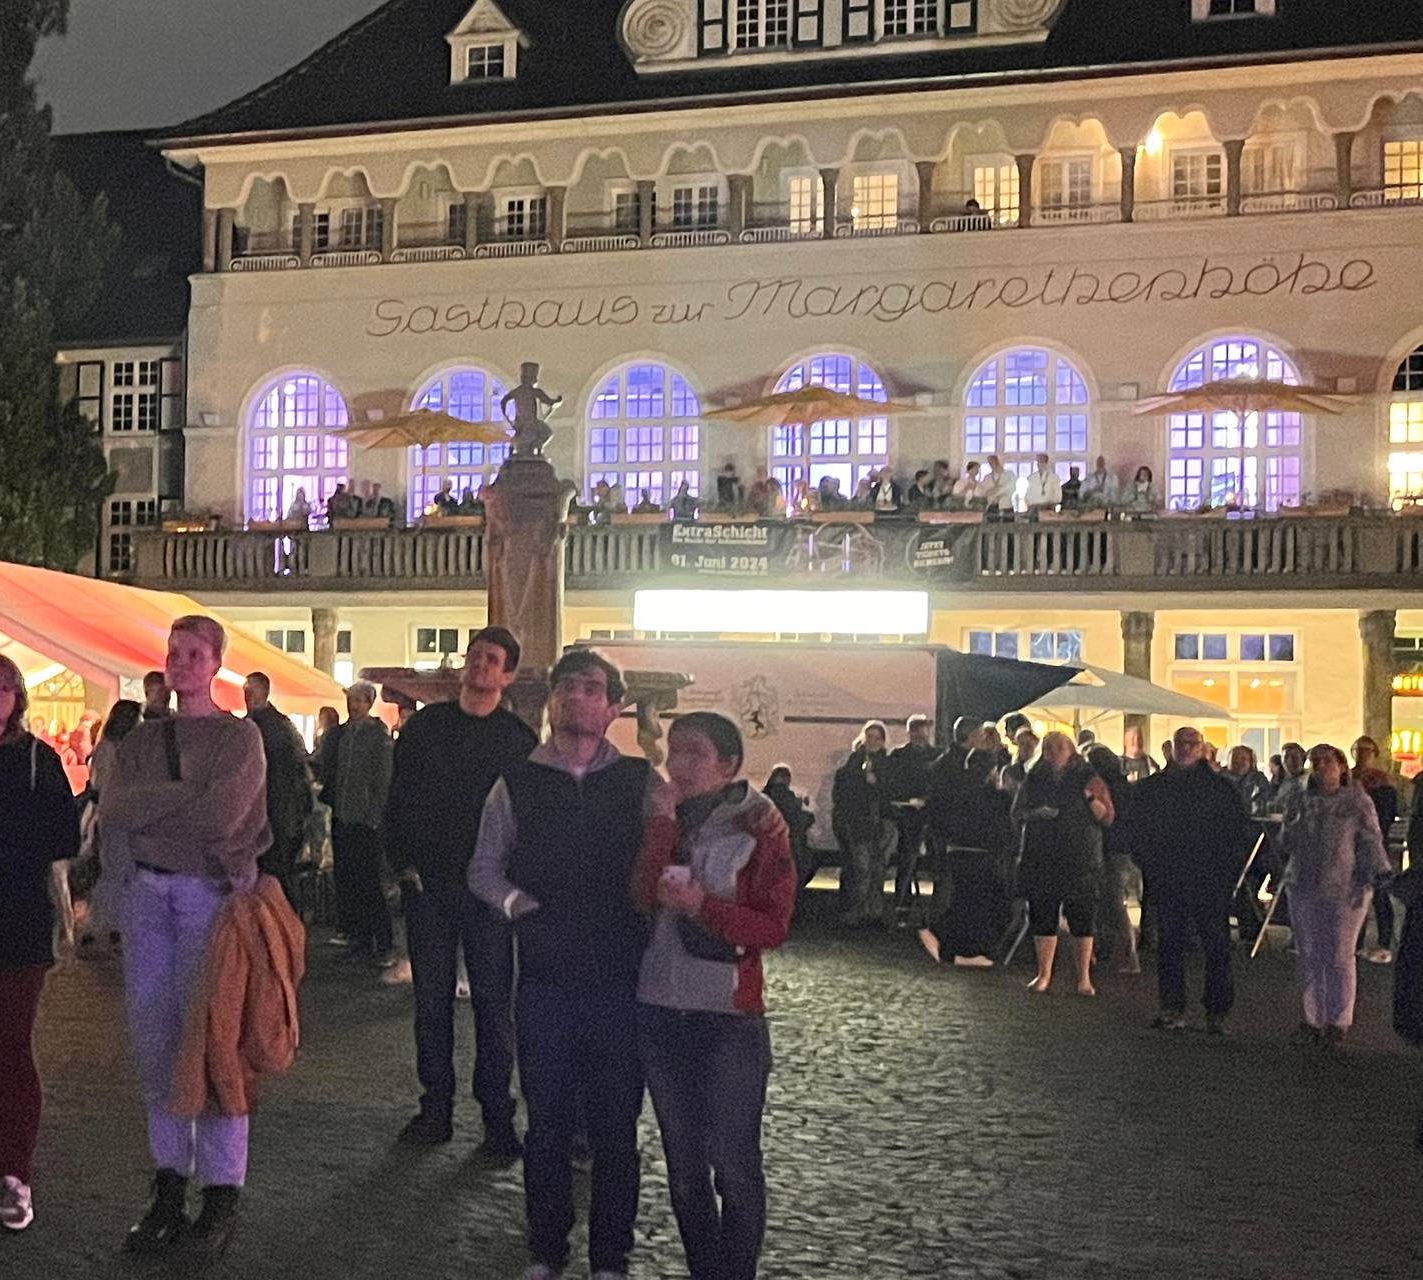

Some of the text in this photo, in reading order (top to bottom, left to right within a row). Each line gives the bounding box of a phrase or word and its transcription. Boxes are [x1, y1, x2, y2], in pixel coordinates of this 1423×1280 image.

[366, 253, 1377, 337] Gasthaus zur Margarethenhöhe
[673, 524, 768, 538] ExtraSchicht
[694, 555, 726, 569] Juni
[730, 556, 768, 569] 2024
